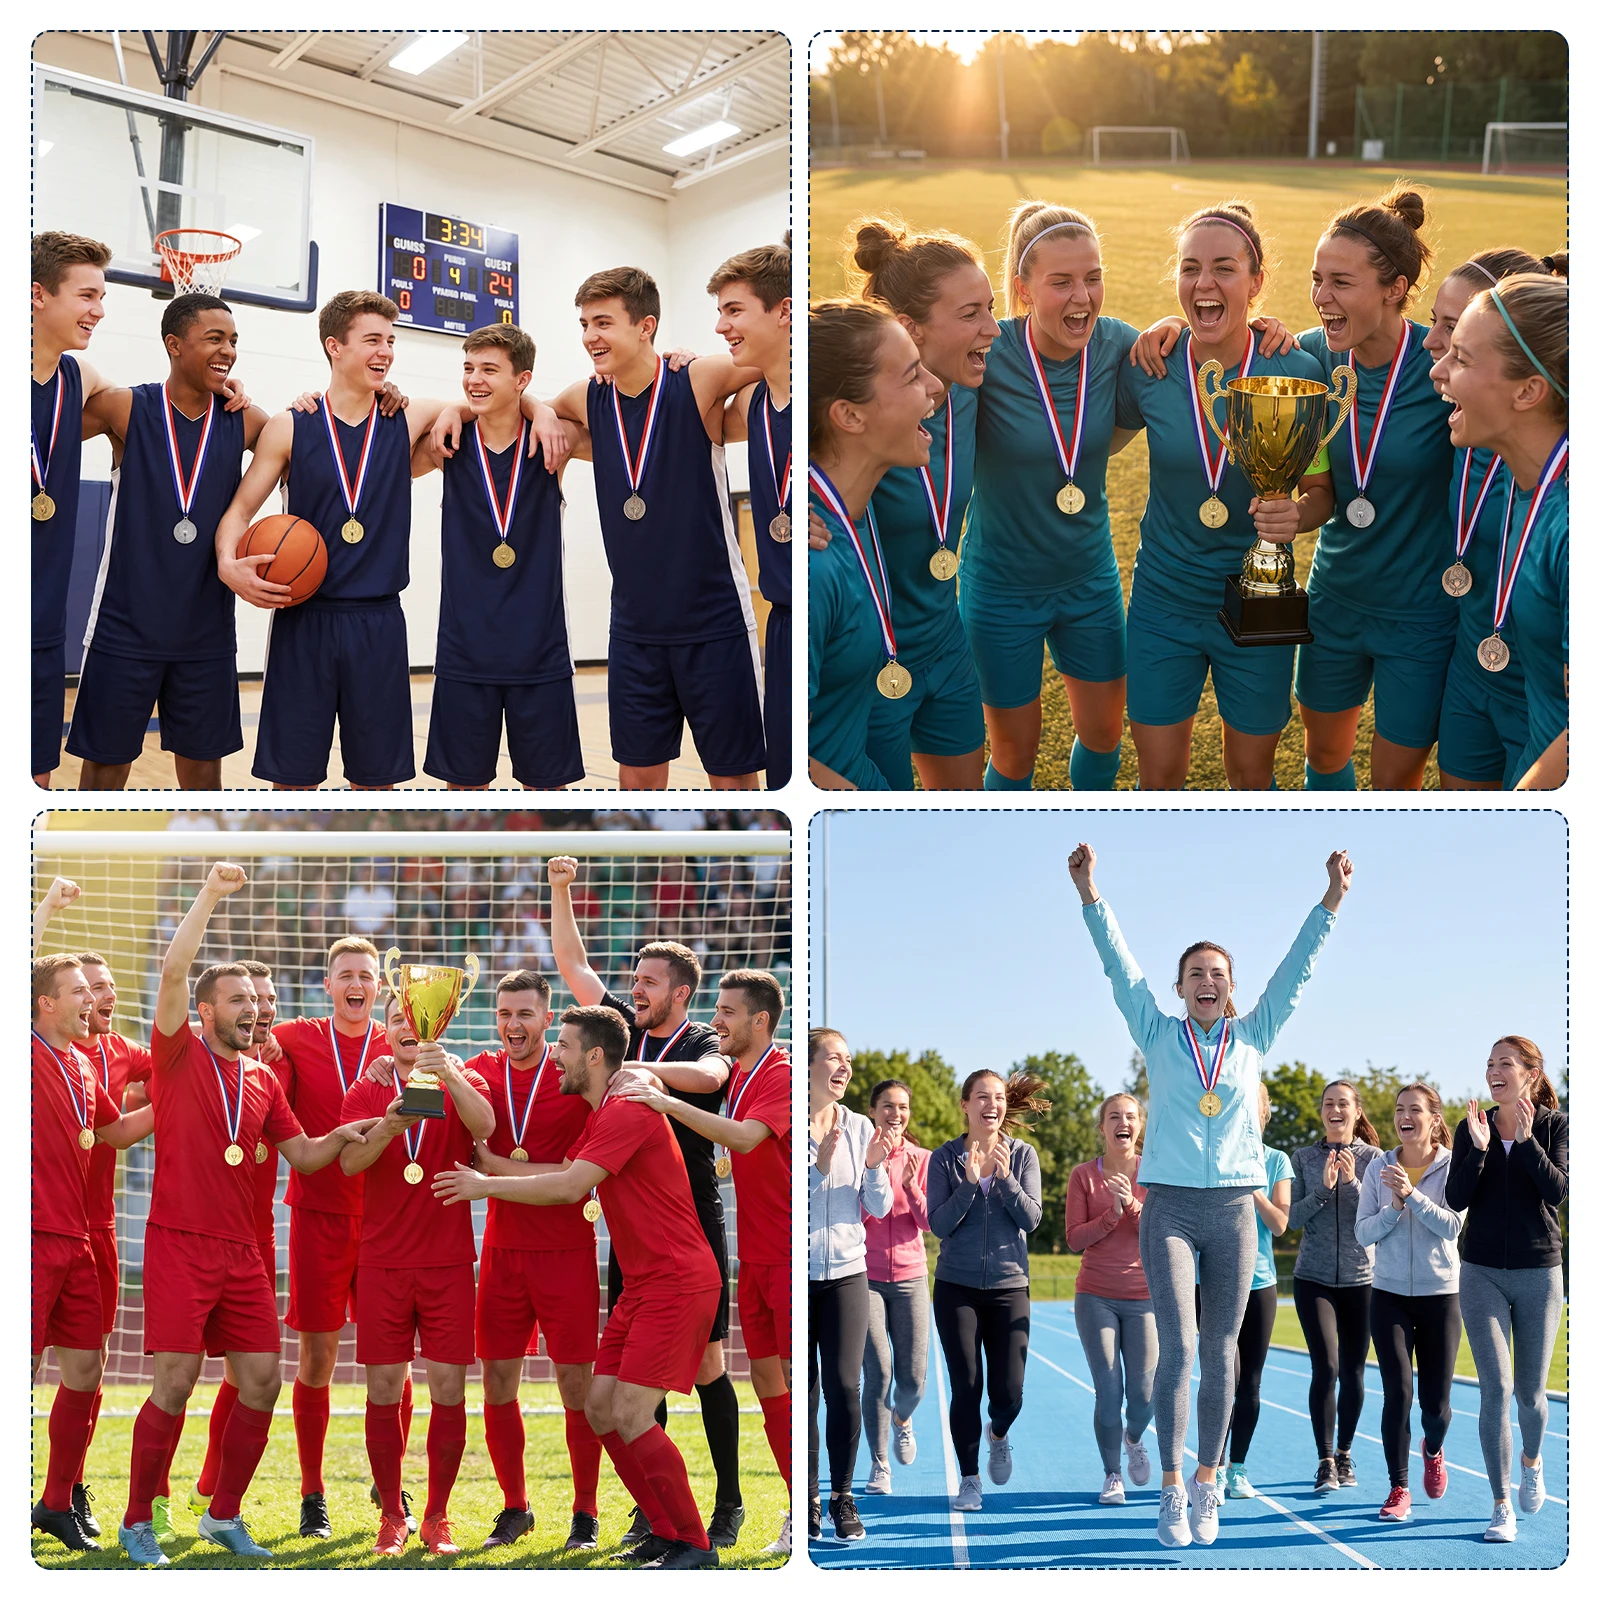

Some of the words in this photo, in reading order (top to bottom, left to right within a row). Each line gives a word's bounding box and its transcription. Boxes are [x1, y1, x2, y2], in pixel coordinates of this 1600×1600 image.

[441, 218, 482, 248] 3:34
[413, 255, 426, 280] 0
[484, 257, 513, 272] GUEST
[450, 267, 460, 285] 4
[489, 272, 513, 296] 24
[400, 290, 411, 310] 0
